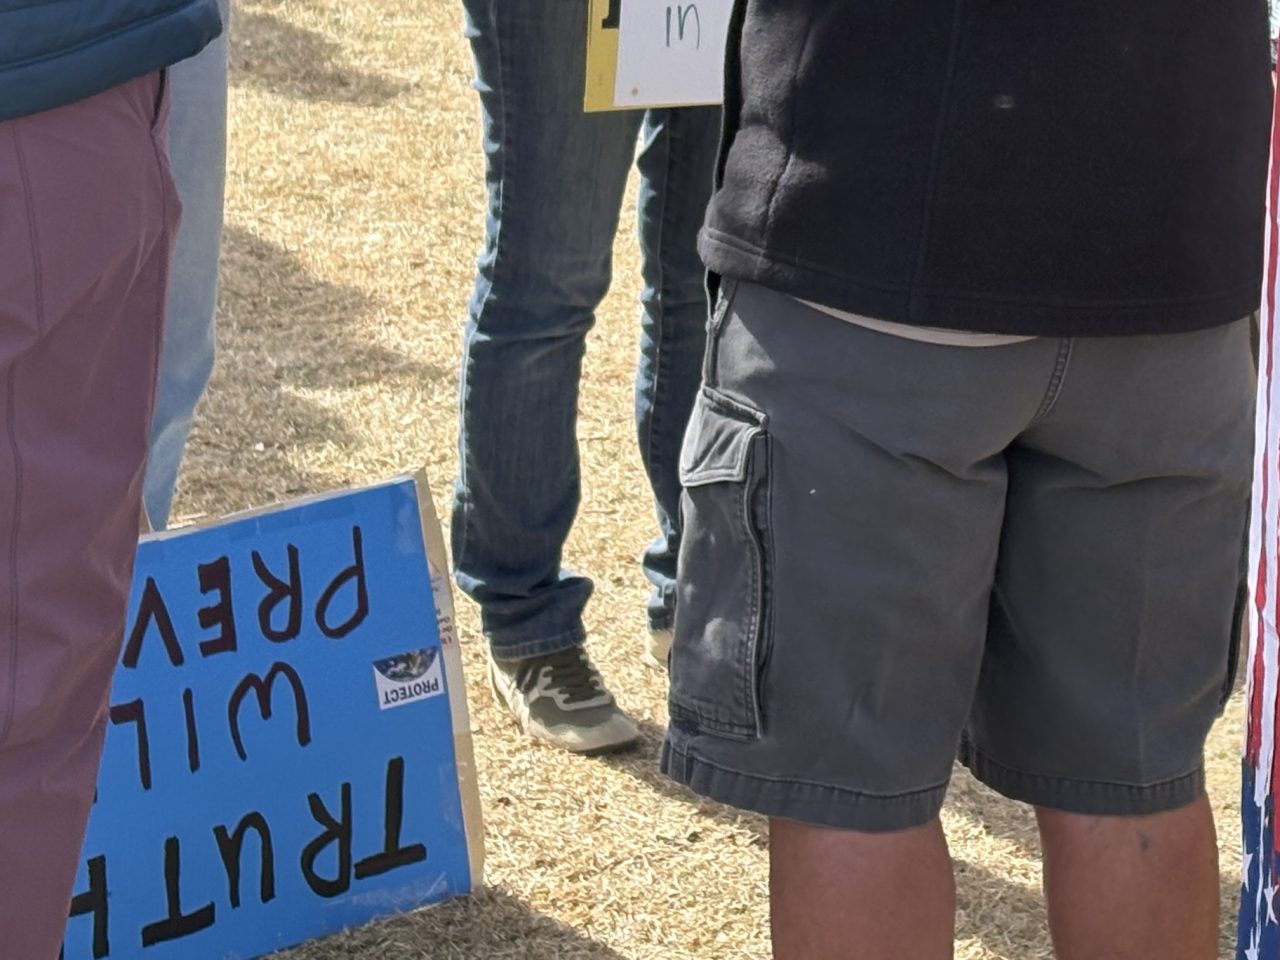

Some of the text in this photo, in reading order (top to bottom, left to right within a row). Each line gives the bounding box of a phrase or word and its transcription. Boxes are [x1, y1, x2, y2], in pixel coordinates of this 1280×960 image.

[121, 525, 370, 669] PREV
[94, 661, 312, 804] WIL
[382, 677, 440, 705] PROTECT
